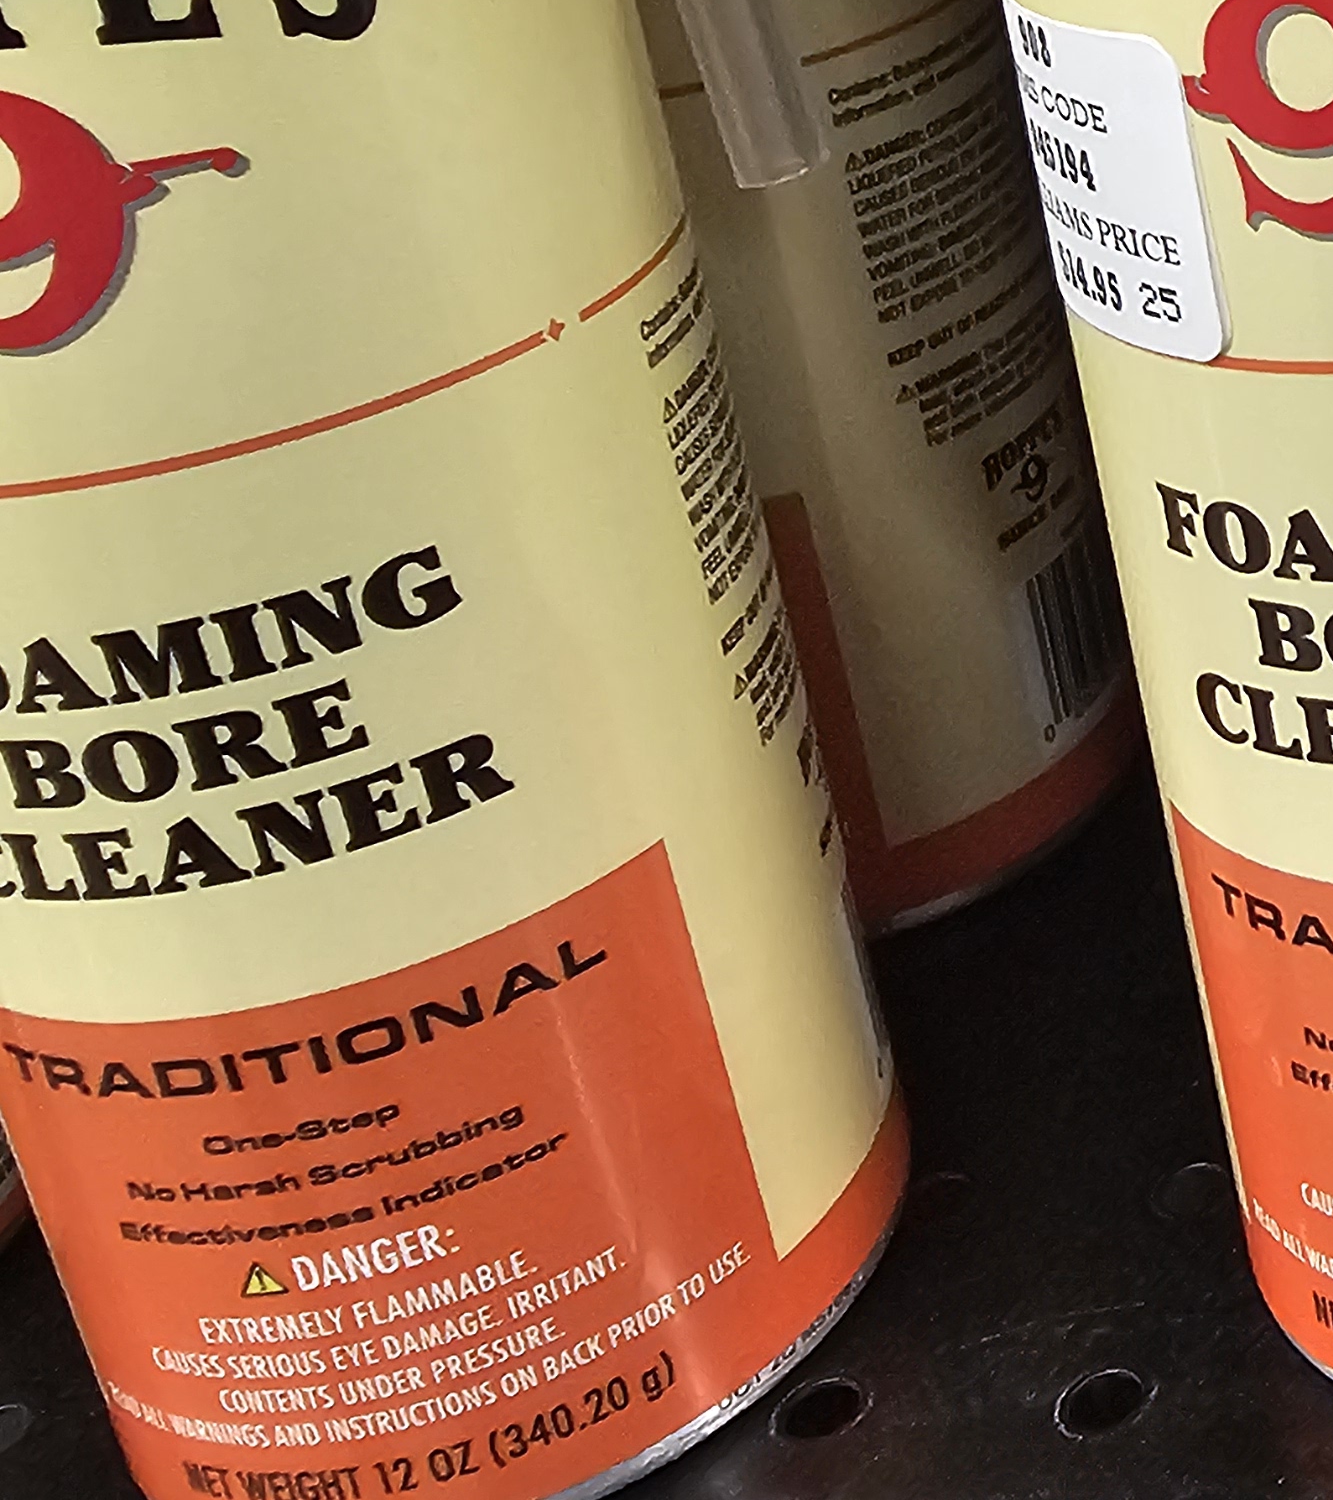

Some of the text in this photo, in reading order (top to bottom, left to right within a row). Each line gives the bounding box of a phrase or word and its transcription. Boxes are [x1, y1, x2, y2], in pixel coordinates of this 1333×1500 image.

[1041, 85, 1107, 134] CODE
[1057, 240, 1122, 312] $14.95
[1138, 281, 1182, 323] 25
[1096, 217, 1181, 267] PRICE
[0, 545, 464, 713] AMING
[0, 679, 371, 808] BORE
[0, 733, 515, 901] LEANER
[3, 940, 607, 1100] TRADITIONAL
[181, 1104, 524, 1202] Harsh Scrubbing
[203, 1103, 400, 1156] One-Step
[120, 1132, 568, 1246] Effectiveness Indicator
[199, 1250, 538, 1345] EXTREMELY FLAMMABLE.
[291, 1224, 461, 1293] DANGER:
[151, 1246, 627, 1380] CAUSES SERIOUS EYE DAMAGE. IRRITANT.
[219, 1317, 567, 1414] CONTENTS UNDER PRESSURE.
[274, 1293, 677, 1449] AND INSTRUCTIONS ON BACK PRIOR
[373, 1374, 631, 1496] 12 OZ (340.20
